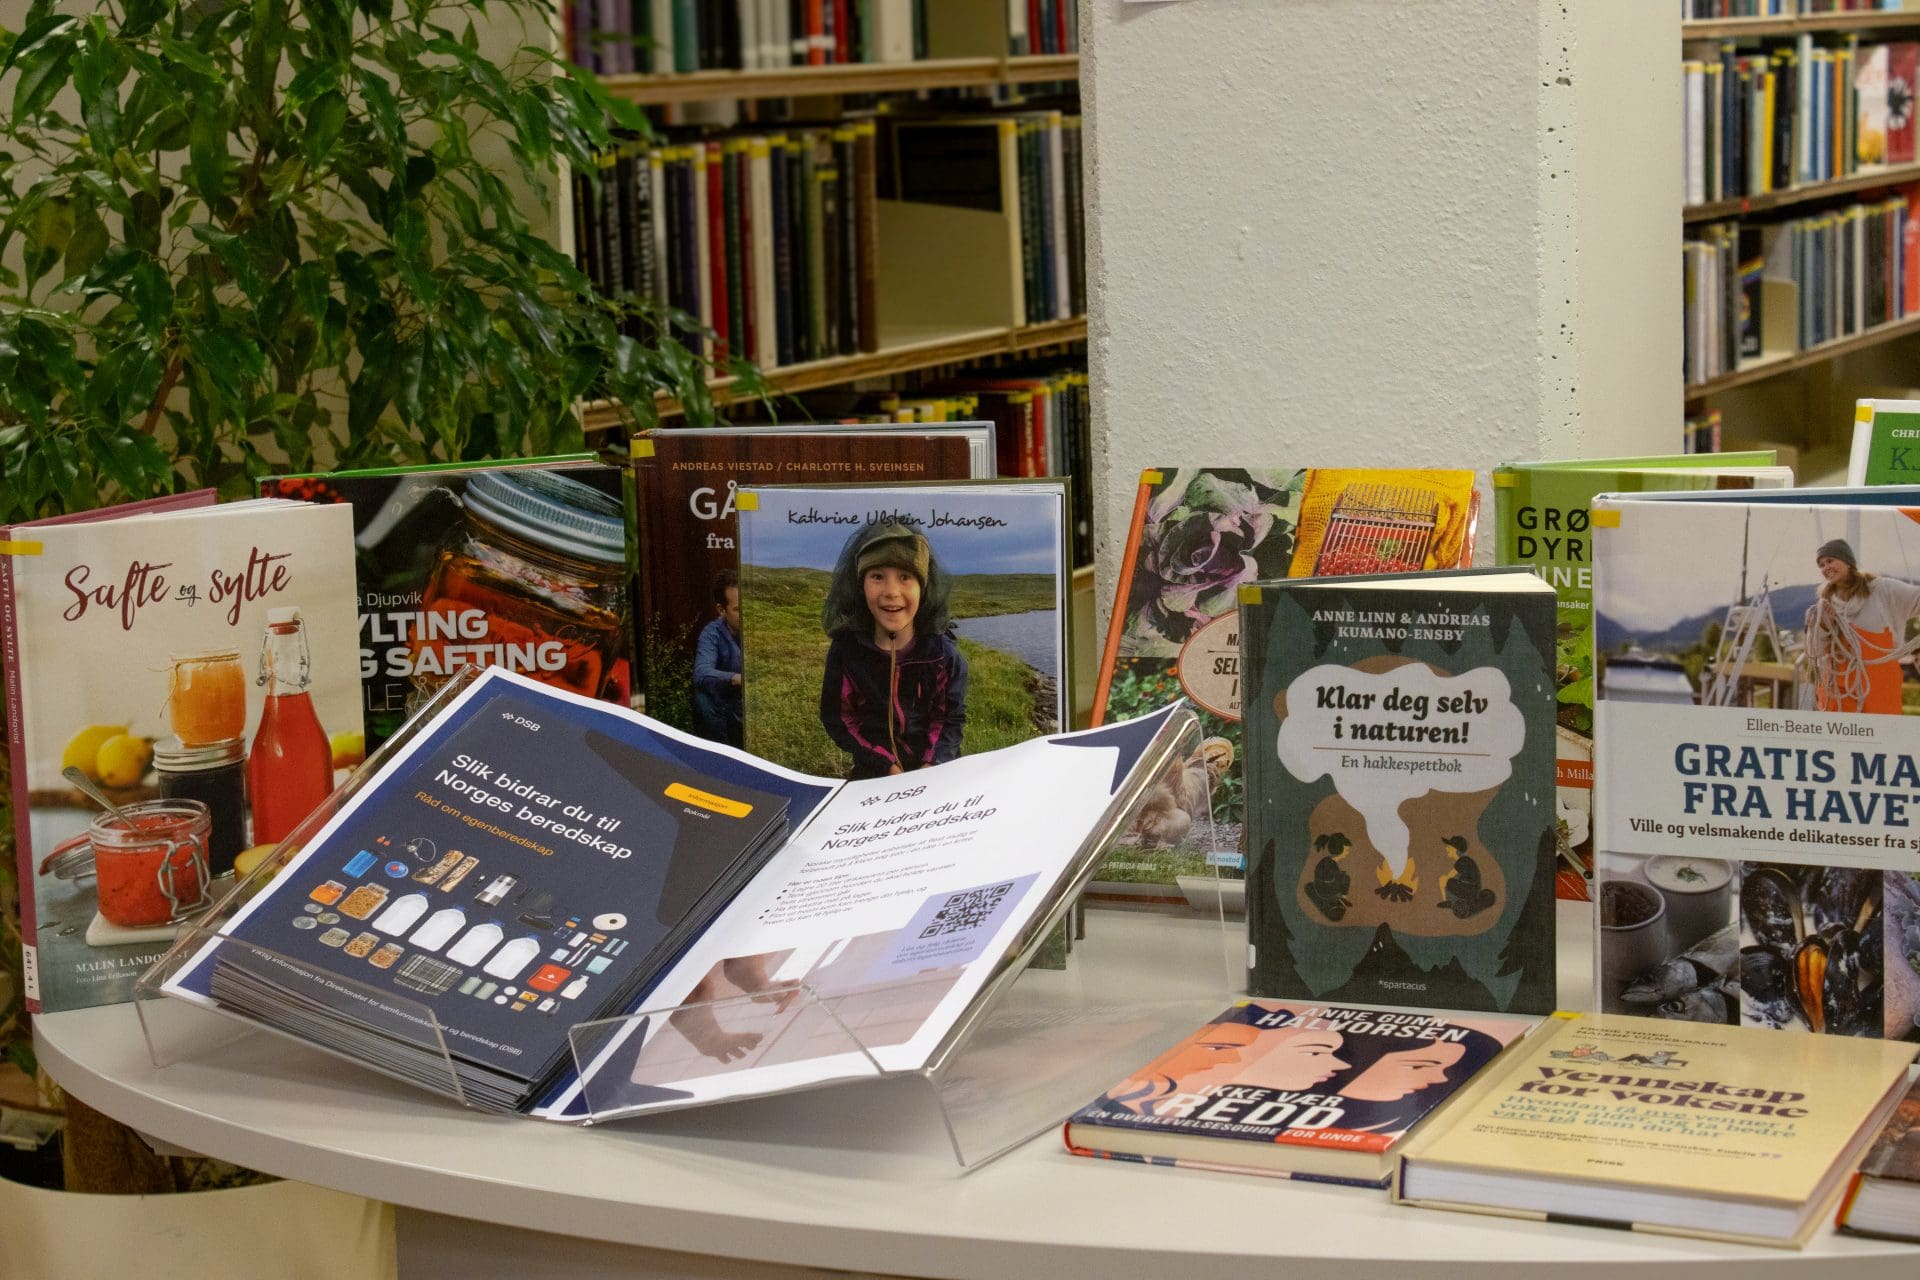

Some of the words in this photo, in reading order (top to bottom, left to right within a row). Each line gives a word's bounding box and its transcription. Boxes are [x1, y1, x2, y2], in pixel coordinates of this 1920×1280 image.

[672, 462, 724, 472] ANDREAS
[726, 462, 774, 472] VIESTAD
[786, 462, 852, 473] CHARLOTTE
[855, 463, 866, 472] H.
[869, 463, 924, 472] SVEINSEN
[788, 508, 861, 525] Kathrine
[866, 509, 926, 528] Ulstein
[928, 508, 1007, 530] Johansen
[1517, 506, 1590, 532] GRØ
[706, 533, 736, 549] fra
[1518, 536, 1592, 562] DYR
[63, 560, 173, 631] Safte
[178, 583, 199, 607] og
[209, 546, 292, 627] sylte
[367, 590, 423, 608] Djupvik
[1312, 610, 1355, 622] ANNE
[1359, 612, 1396, 623] LINN
[1400, 613, 1412, 624] &
[1416, 612, 1491, 626] ANDREAS
[1338, 627, 1465, 641] KUMANO-ENSBY
[2, 562, 10, 603] SAFTE
[6, 627, 15, 663] SYLTE
[11, 697, 20, 744] Landqvist
[385, 641, 568, 678] SAFTING
[1316, 685, 1376, 709] Klar
[1383, 687, 1429, 720] deg
[1437, 689, 1488, 714] selv
[513, 715, 541, 732] DSB
[1334, 716, 1343, 739] i
[1350, 721, 1469, 743] naturen!
[1746, 718, 1823, 735] Ellen-Beate
[1826, 721, 1875, 737] Wollen
[1341, 755, 1359, 768] En
[1363, 756, 1463, 775] hakkespettbok
[1675, 742, 1836, 784] GRATIS
[1851, 752, 1920, 788] MA
[451, 753, 496, 781] Slik
[493, 770, 562, 811] bidrar
[562, 796, 592, 824] du
[593, 809, 622, 834] til
[885, 785, 928, 803] DSB
[1683, 781, 1773, 819] FRA
[414, 790, 440, 809] Råd
[440, 804, 462, 819] om
[461, 811, 554, 858] egenberedskap
[434, 768, 514, 815] Norges
[515, 799, 633, 861] beredskap
[820, 830, 890, 850] Norges
[894, 807, 998, 836] beredskap
[834, 817, 868, 836] Slik
[873, 808, 930, 829] bidrar
[934, 802, 960, 815] du
[963, 794, 985, 808] til
[1630, 817, 1663, 834] Ville
[1667, 823, 1684, 838] og
[1689, 822, 1785, 842] velsmakende
[1789, 829, 1880, 848] delikatesser
[1885, 834, 1906, 849] fra
[76, 959, 115, 974] MALIN
[271, 956, 315, 979] informasjon
[325, 980, 369, 1003] Direktoratet
[367, 998, 380, 1007] for
[448, 1027, 459, 1036] og
[459, 1030, 501, 1049] beredskap
[499, 1043, 523, 1056] (DSB)
[1301, 1007, 1371, 1022] ANNE
[1377, 1013, 1450, 1027] GUNN
[1256, 1013, 1470, 1042] HALVORSEN
[1153, 1093, 1345, 1130] REDD
[1197, 1085, 1272, 1105] IKKE
[1276, 1091, 1344, 1108] VÆR
[1505, 1095, 1607, 1112] Hvordan
[1643, 1109, 1688, 1121] nye
[1695, 1114, 1779, 1128] venner
[1515, 1080, 1601, 1098] for
[1610, 1090, 1808, 1118] voksne
[1086, 1110, 1111, 1119] EN
[1111, 1112, 1282, 1136] OVERLEVELSESGUIDE
[1281, 1129, 1317, 1139] FOR
[1320, 1131, 1365, 1143] UNGE
[1499, 1102, 1580, 1116] voksen
[1660, 1118, 1689, 1129] og
[1726, 1124, 1796, 1139] bedre
[1583, 1118, 1635, 1129] dem
[1642, 1124, 1673, 1133] du
[1680, 1126, 1721, 1138] har
